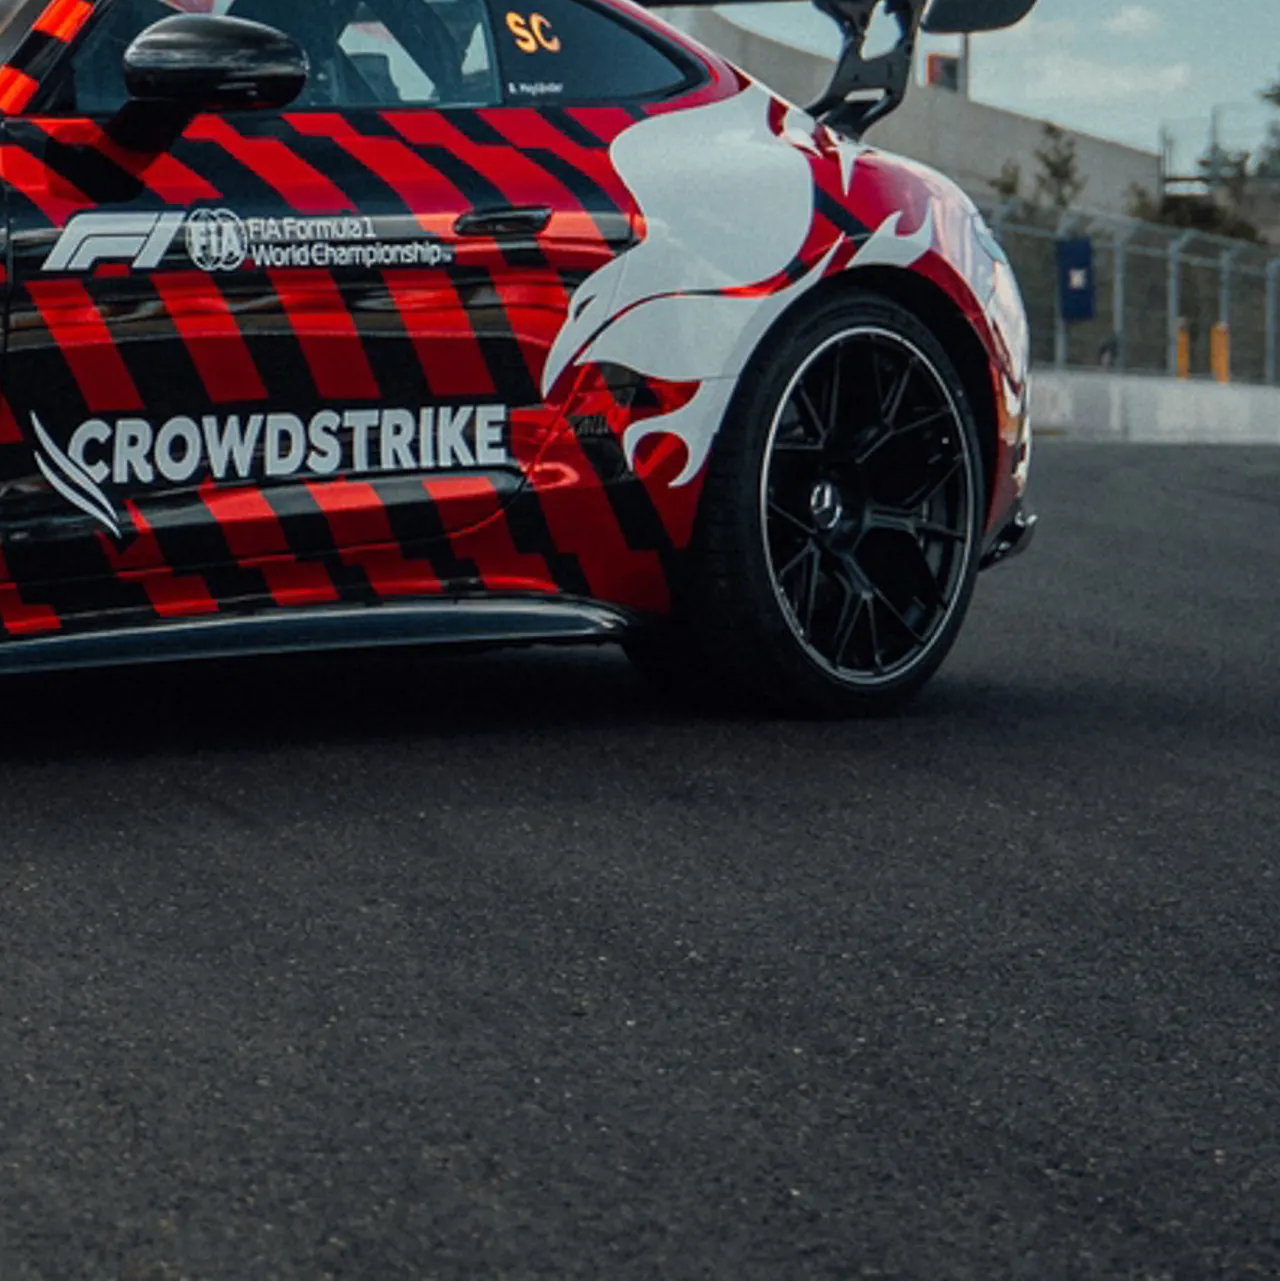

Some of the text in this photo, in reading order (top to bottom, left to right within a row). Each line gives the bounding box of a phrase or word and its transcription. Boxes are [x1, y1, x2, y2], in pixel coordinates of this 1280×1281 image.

[505, 11, 561, 53] SC
[40, 211, 188, 271] F1
[249, 216, 377, 240] FIA Formula 1
[251, 241, 441, 268] World Championship
[67, 404, 508, 485] CROWDSTRIKE
